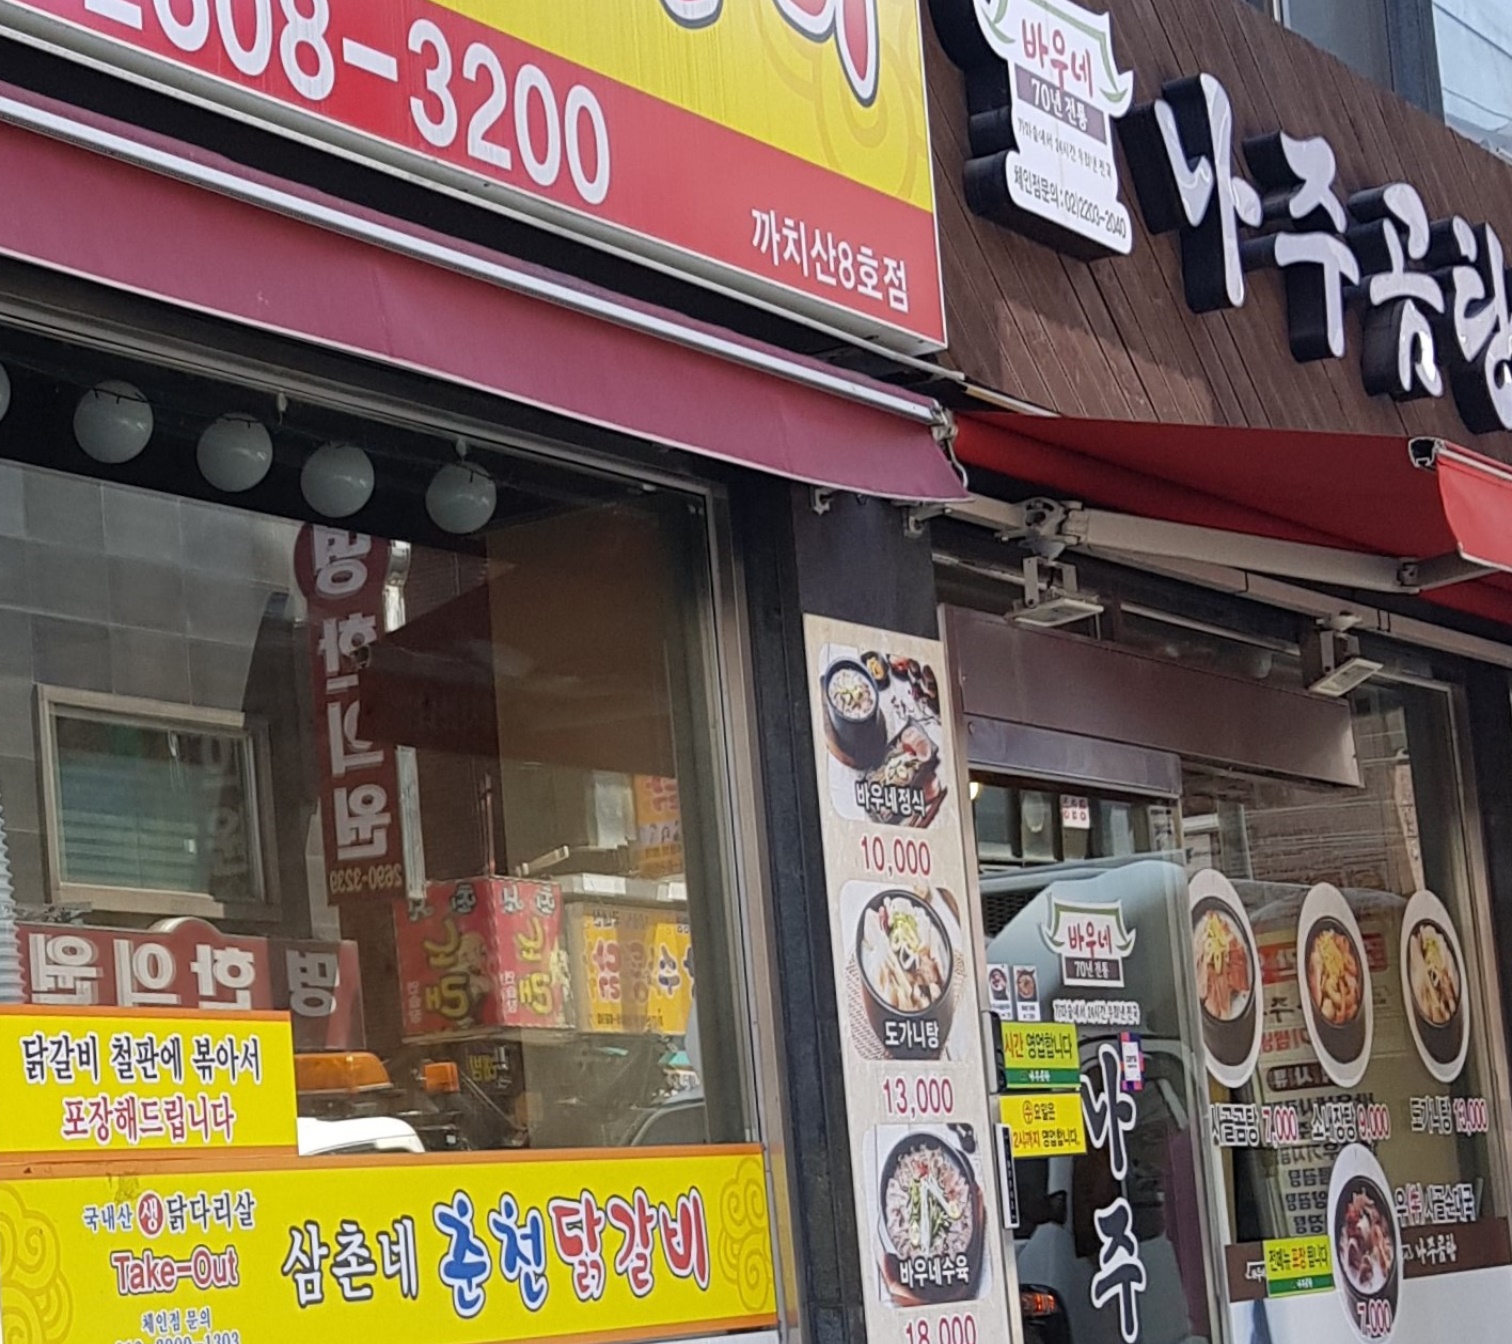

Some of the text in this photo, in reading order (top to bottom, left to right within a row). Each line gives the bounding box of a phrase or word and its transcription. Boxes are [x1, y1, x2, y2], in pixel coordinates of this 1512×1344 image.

[1022, 18, 1093, 98] 바우네
[1031, 78, 1063, 119] 70년
[751, 206, 909, 314] 까치산8호점
[1155, 72, 1512, 430] 나주곰탕
[855, 781, 926, 818] 바우네정식
[861, 835, 931, 876] 10,000
[1068, 921, 1112, 957] 바우네
[884, 1019, 940, 1050] 도가니탕
[22, 1033, 261, 1083] 닭갈비 철판에 볶아서
[883, 1076, 954, 1117] 13,000
[63, 1095, 235, 1142] 포장해드립니다
[84, 1205, 133, 1231] 국내산
[112, 1245, 238, 1295] Take-Out
[282, 1216, 419, 1307] 삼촌네
[899, 1256, 970, 1288] 바우네수육
[143, 1308, 211, 1333] 체인점 문의
